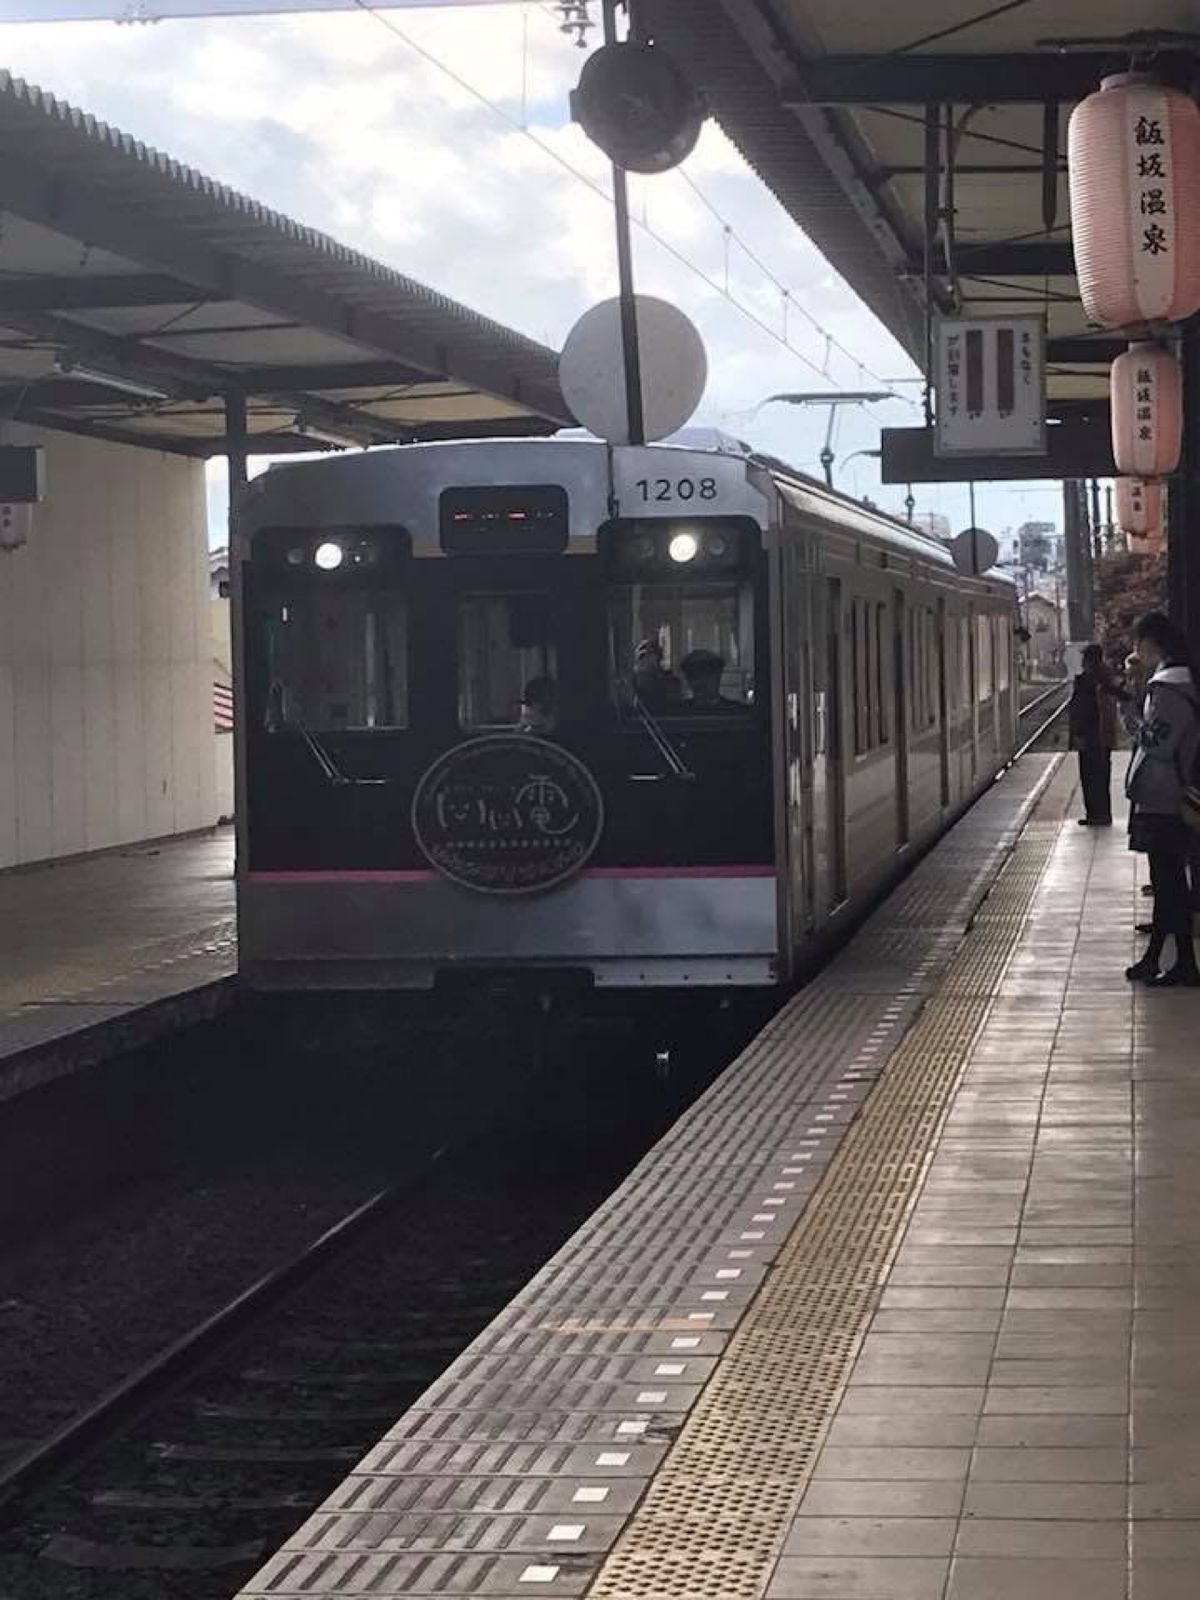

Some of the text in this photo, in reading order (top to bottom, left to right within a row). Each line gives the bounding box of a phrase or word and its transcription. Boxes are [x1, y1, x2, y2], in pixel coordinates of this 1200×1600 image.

[1134, 115, 1168, 256] 飯坂温泉
[1136, 368, 1152, 440] 飯坂温泉
[636, 478, 718, 501] 1208
